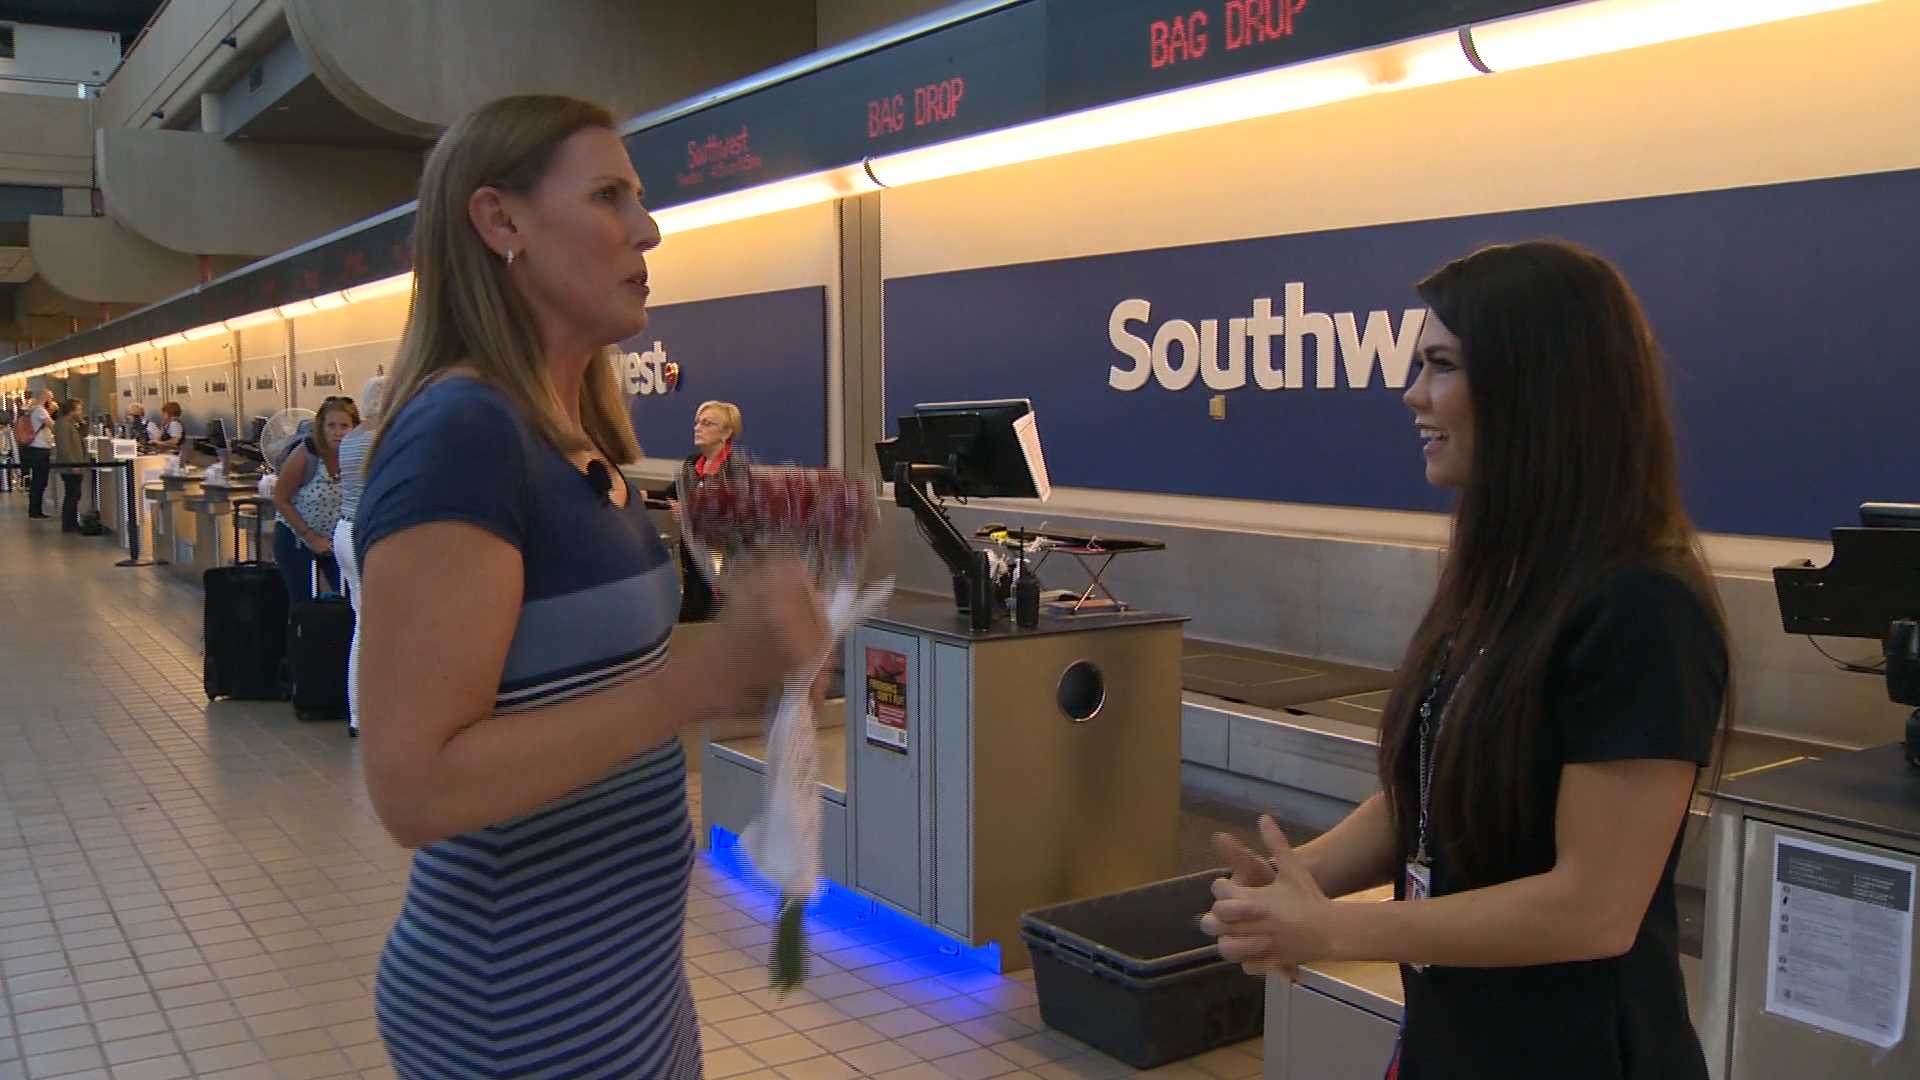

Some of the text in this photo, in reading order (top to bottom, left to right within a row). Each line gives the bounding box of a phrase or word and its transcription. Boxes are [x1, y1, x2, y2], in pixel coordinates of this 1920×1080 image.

[1150, 0, 1308, 69] BAG DROP
[867, 76, 966, 138] BAG DROP
[1108, 281, 1428, 392] Southw
